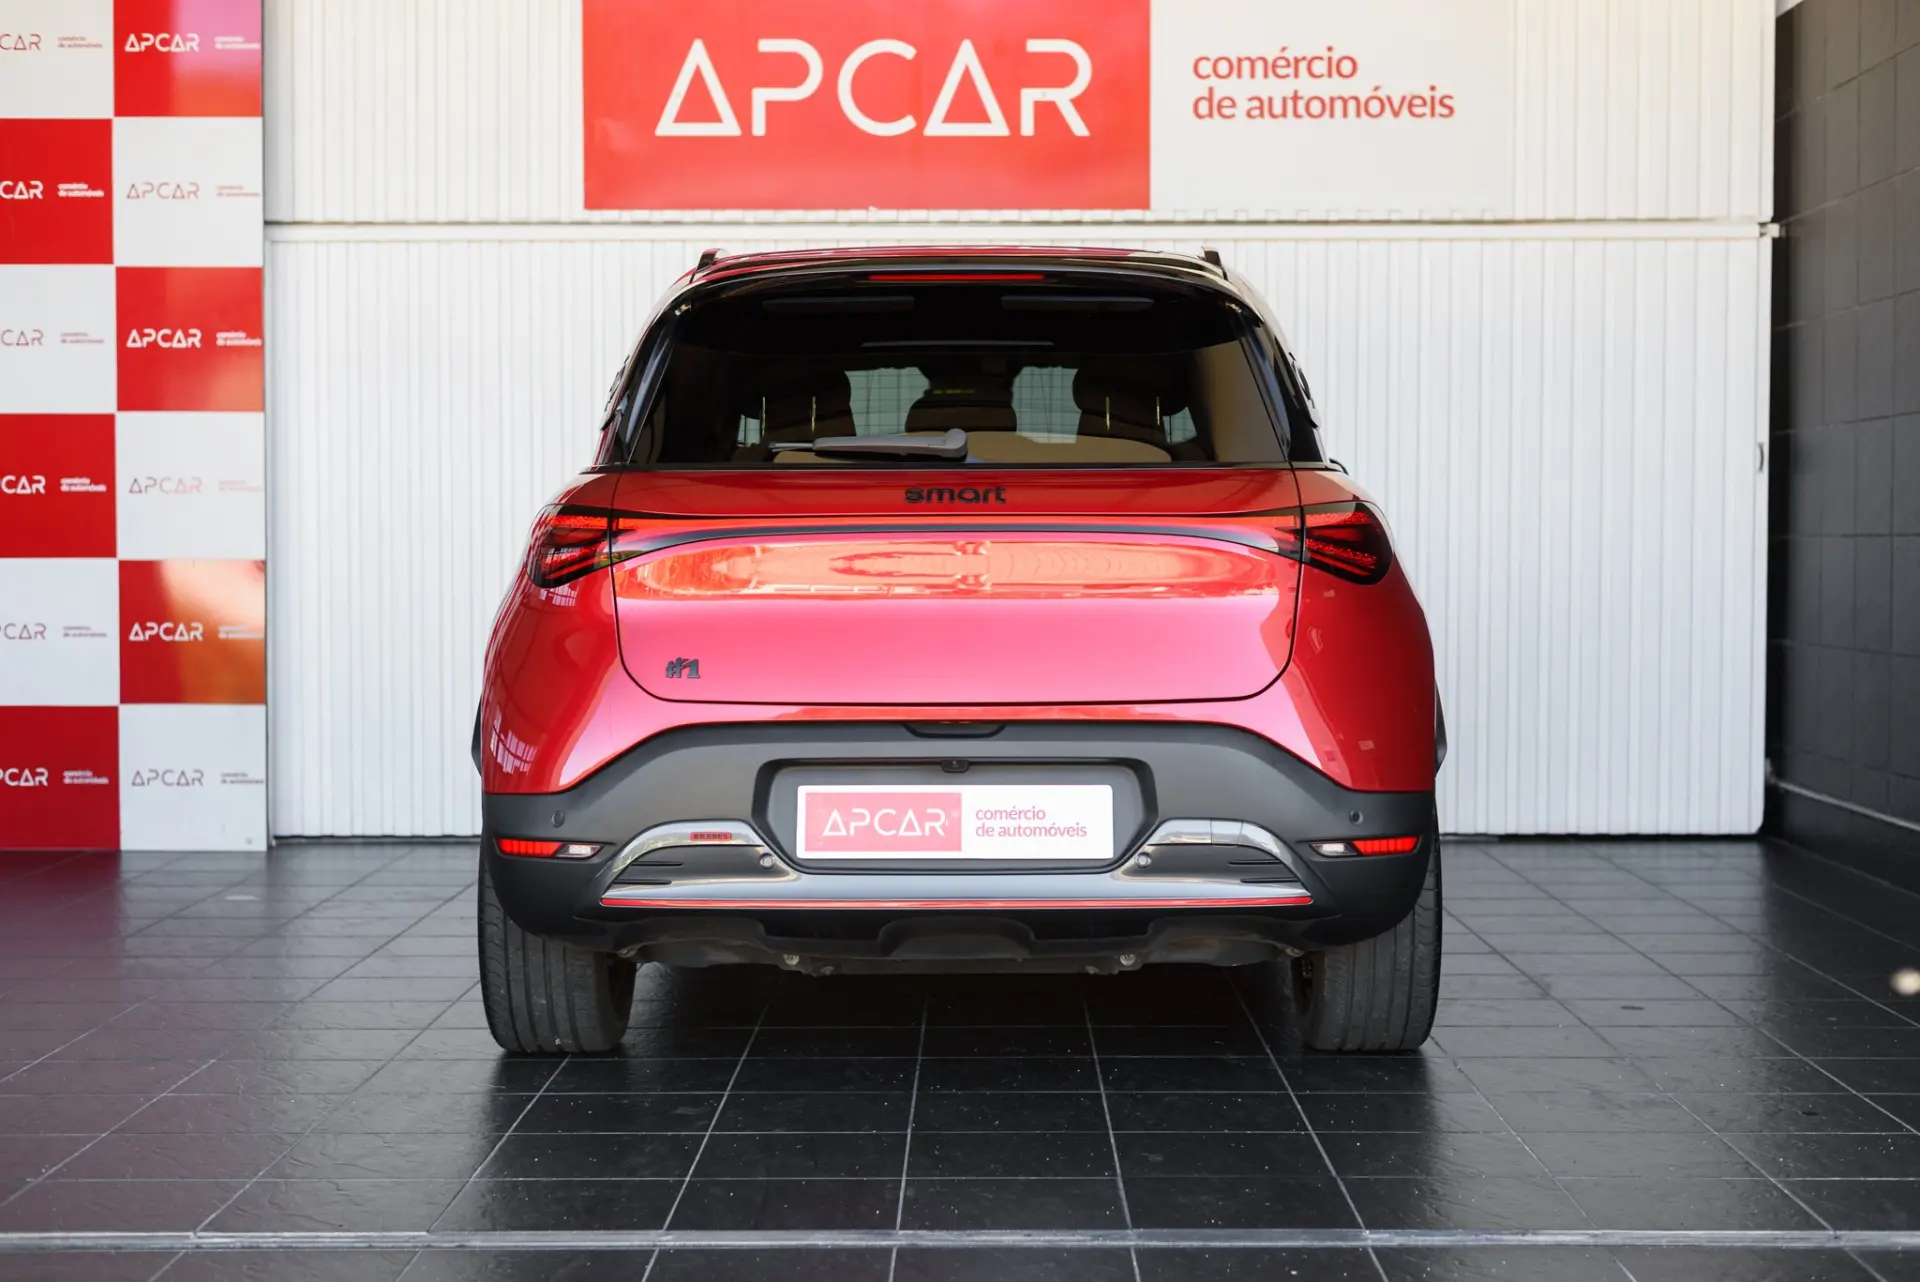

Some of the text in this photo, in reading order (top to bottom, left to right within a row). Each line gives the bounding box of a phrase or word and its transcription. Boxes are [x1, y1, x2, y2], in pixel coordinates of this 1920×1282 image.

[124, 33, 201, 52] APCAR
[1192, 45, 1359, 80] comércio
[655, 38, 1093, 137] APCAR
[1192, 84, 1456, 120] de automóveis
[126, 182, 201, 200] APCAR
[126, 328, 202, 348] APCAR
[128, 476, 204, 495] APCAR
[904, 486, 1007, 504] smart
[0, 622, 47, 641] CAR
[128, 621, 204, 642] APCAR
[665, 656, 701, 679] #1
[131, 769, 205, 787] APCAR
[821, 808, 946, 837] APCAR
[975, 805, 1046, 821] comércio
[975, 822, 1088, 838] de automóveis
